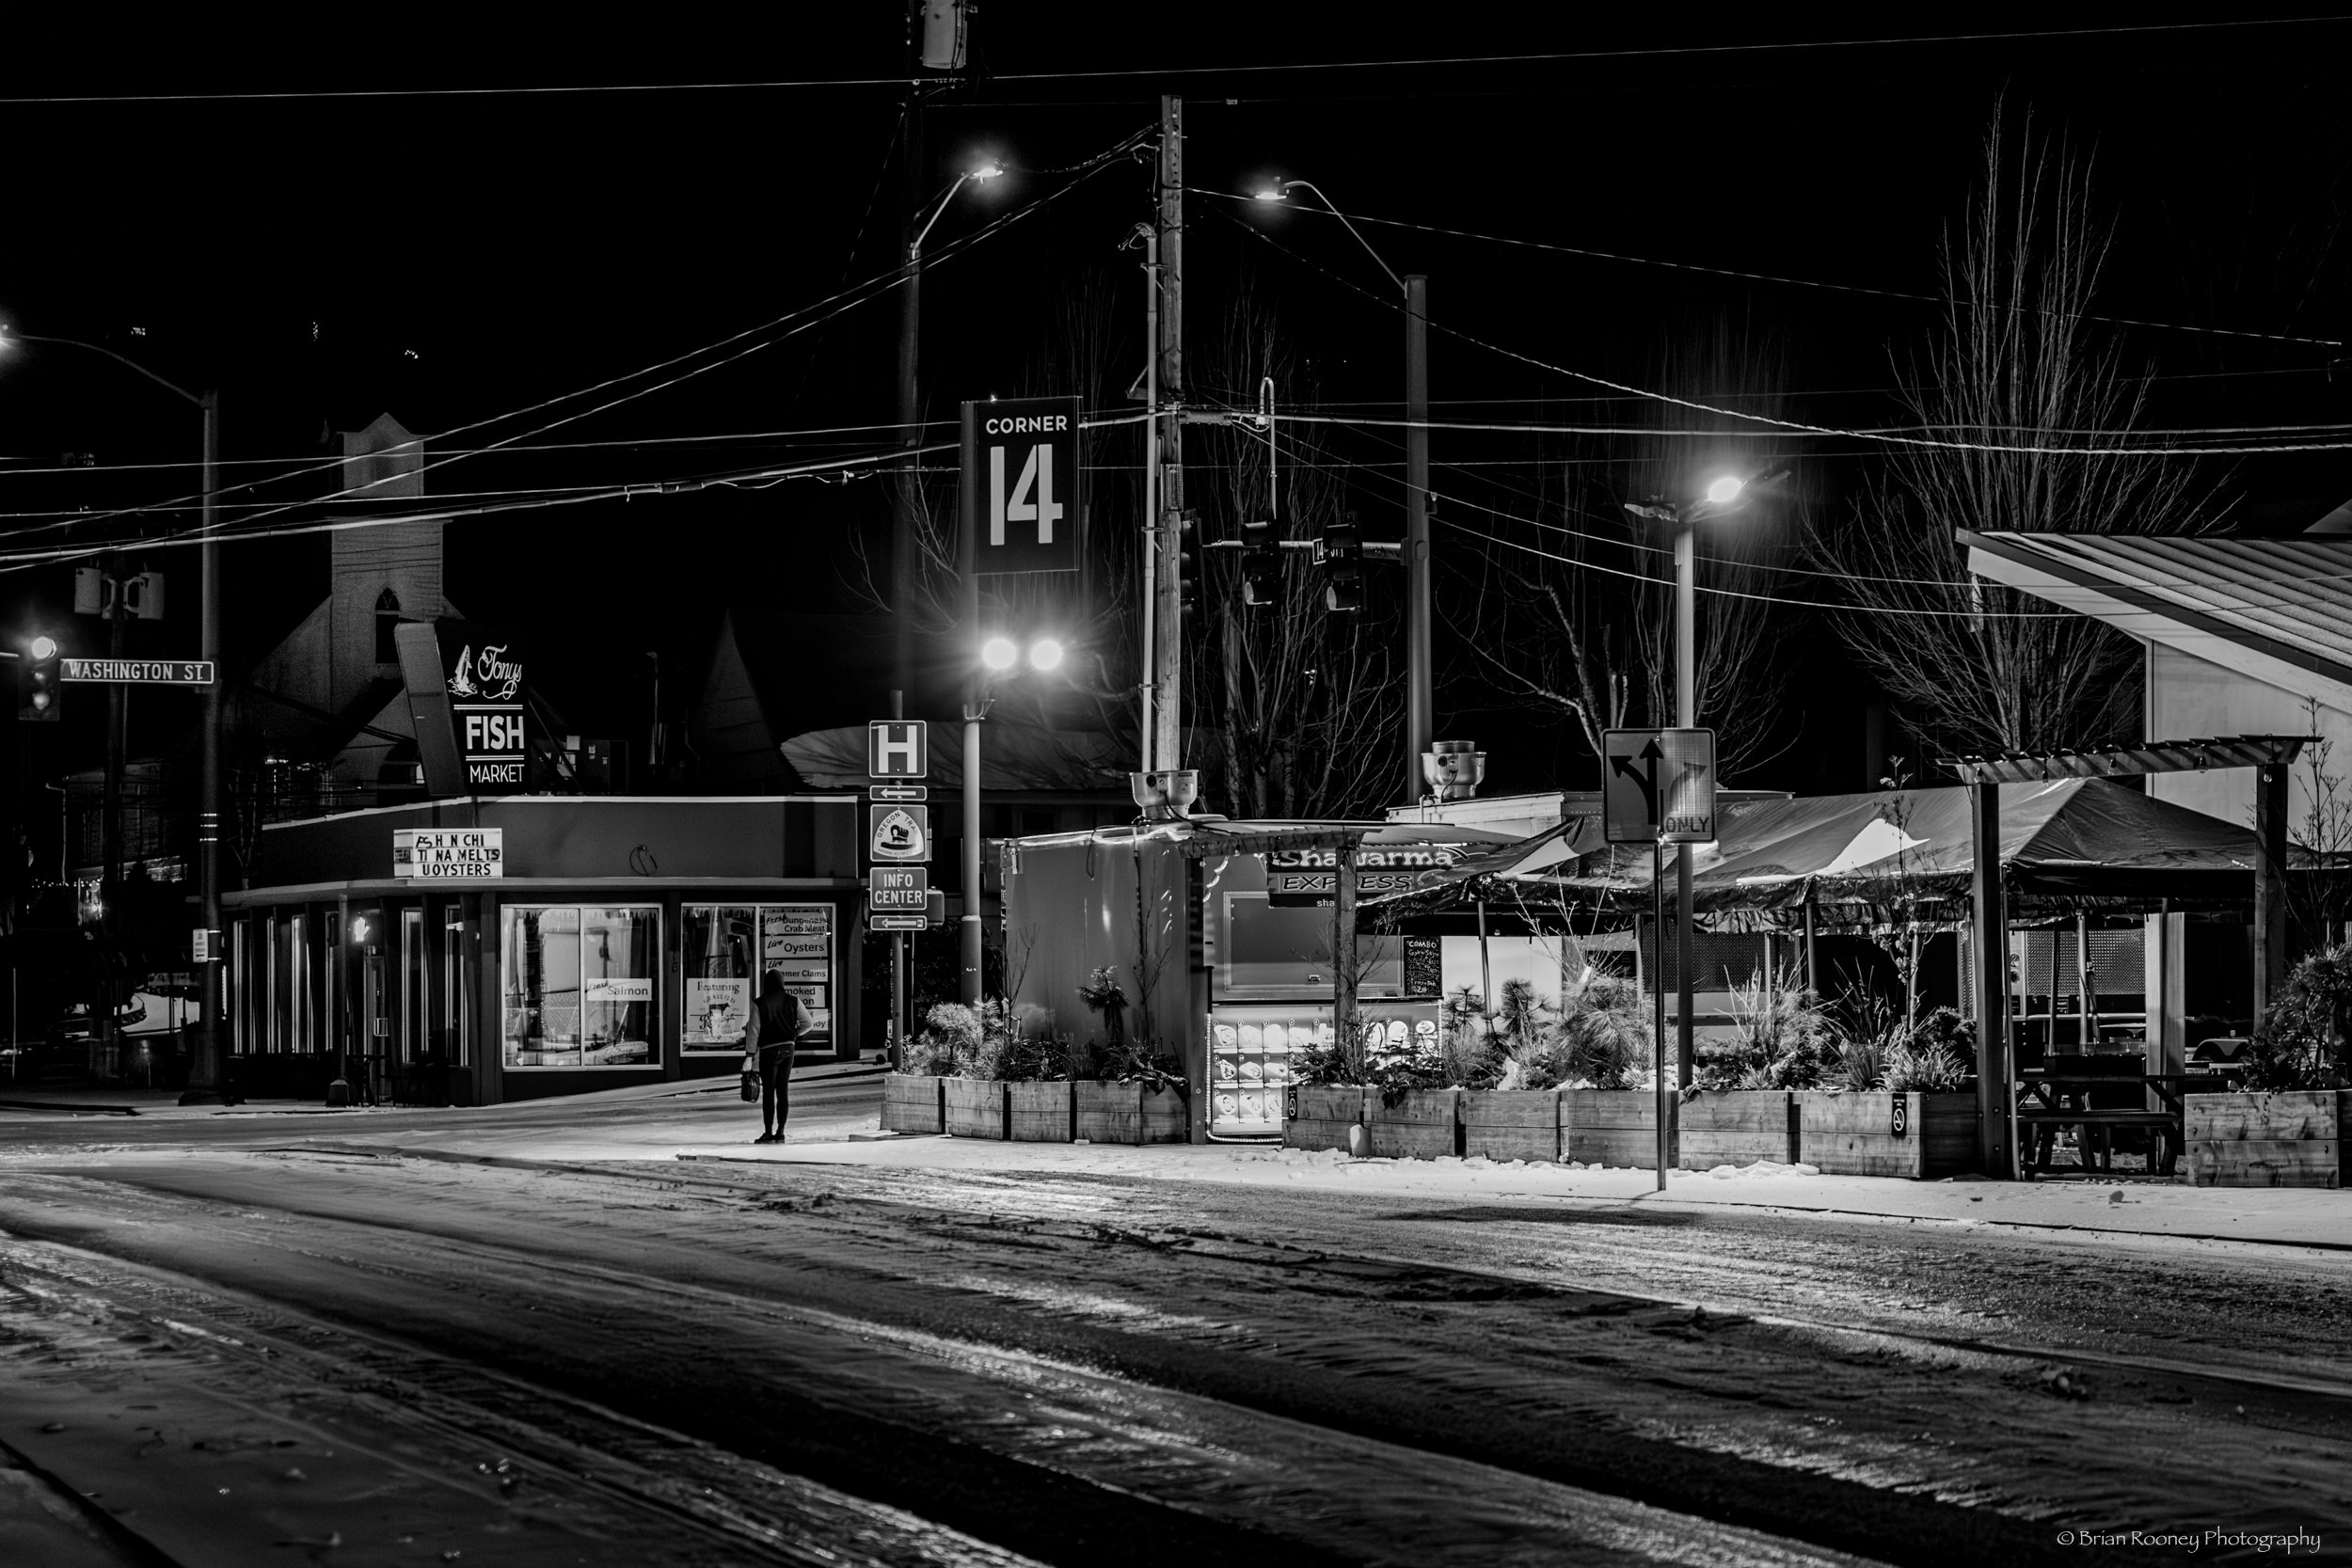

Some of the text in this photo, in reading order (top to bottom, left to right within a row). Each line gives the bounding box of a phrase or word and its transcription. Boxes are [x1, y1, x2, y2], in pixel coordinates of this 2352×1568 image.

[986, 415, 1067, 435] CORNER
[990, 443, 1063, 546] 14
[69, 661, 173, 680] WASHINGTON
[466, 715, 525, 751] FISH
[878, 724, 917, 773] H
[469, 764, 525, 784] MARKET
[877, 812, 900, 837] OREGON
[1665, 816, 1709, 833] ONLY
[456, 848, 501, 862] MELTS
[883, 873, 914, 887] INFO
[1282, 875, 1411, 892] EXPESS
[874, 890, 923, 904] CENTER
[784, 942, 825, 955] Oysters
[608, 986, 648, 996] Salmon
[697, 981, 740, 994] Featuring
[785, 987, 816, 995] moked
